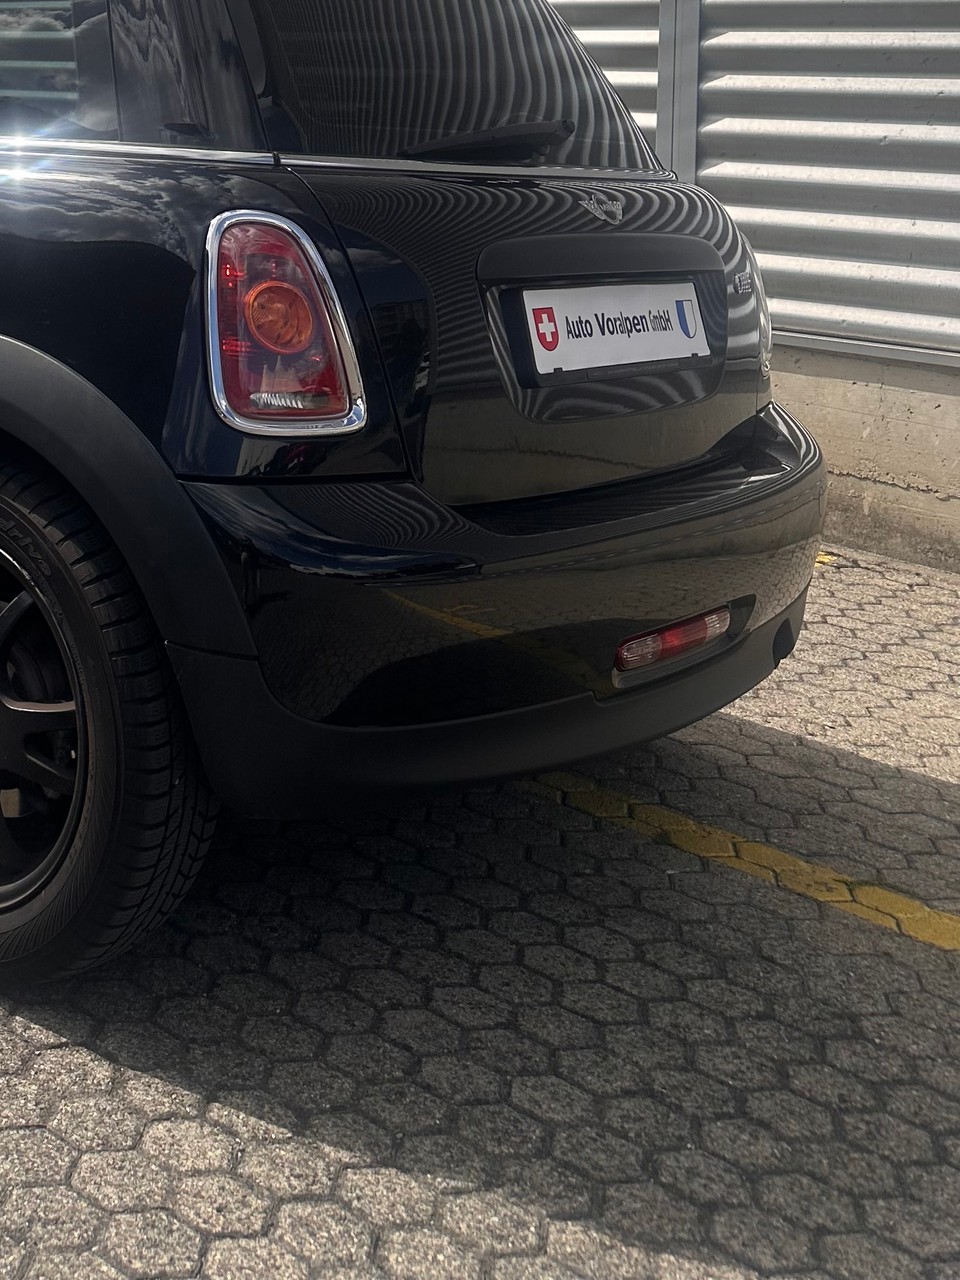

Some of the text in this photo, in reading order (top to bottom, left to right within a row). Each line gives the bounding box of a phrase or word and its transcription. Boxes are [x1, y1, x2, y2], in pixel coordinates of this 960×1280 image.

[565, 309, 674, 340] Auto Voralpen GmbH
